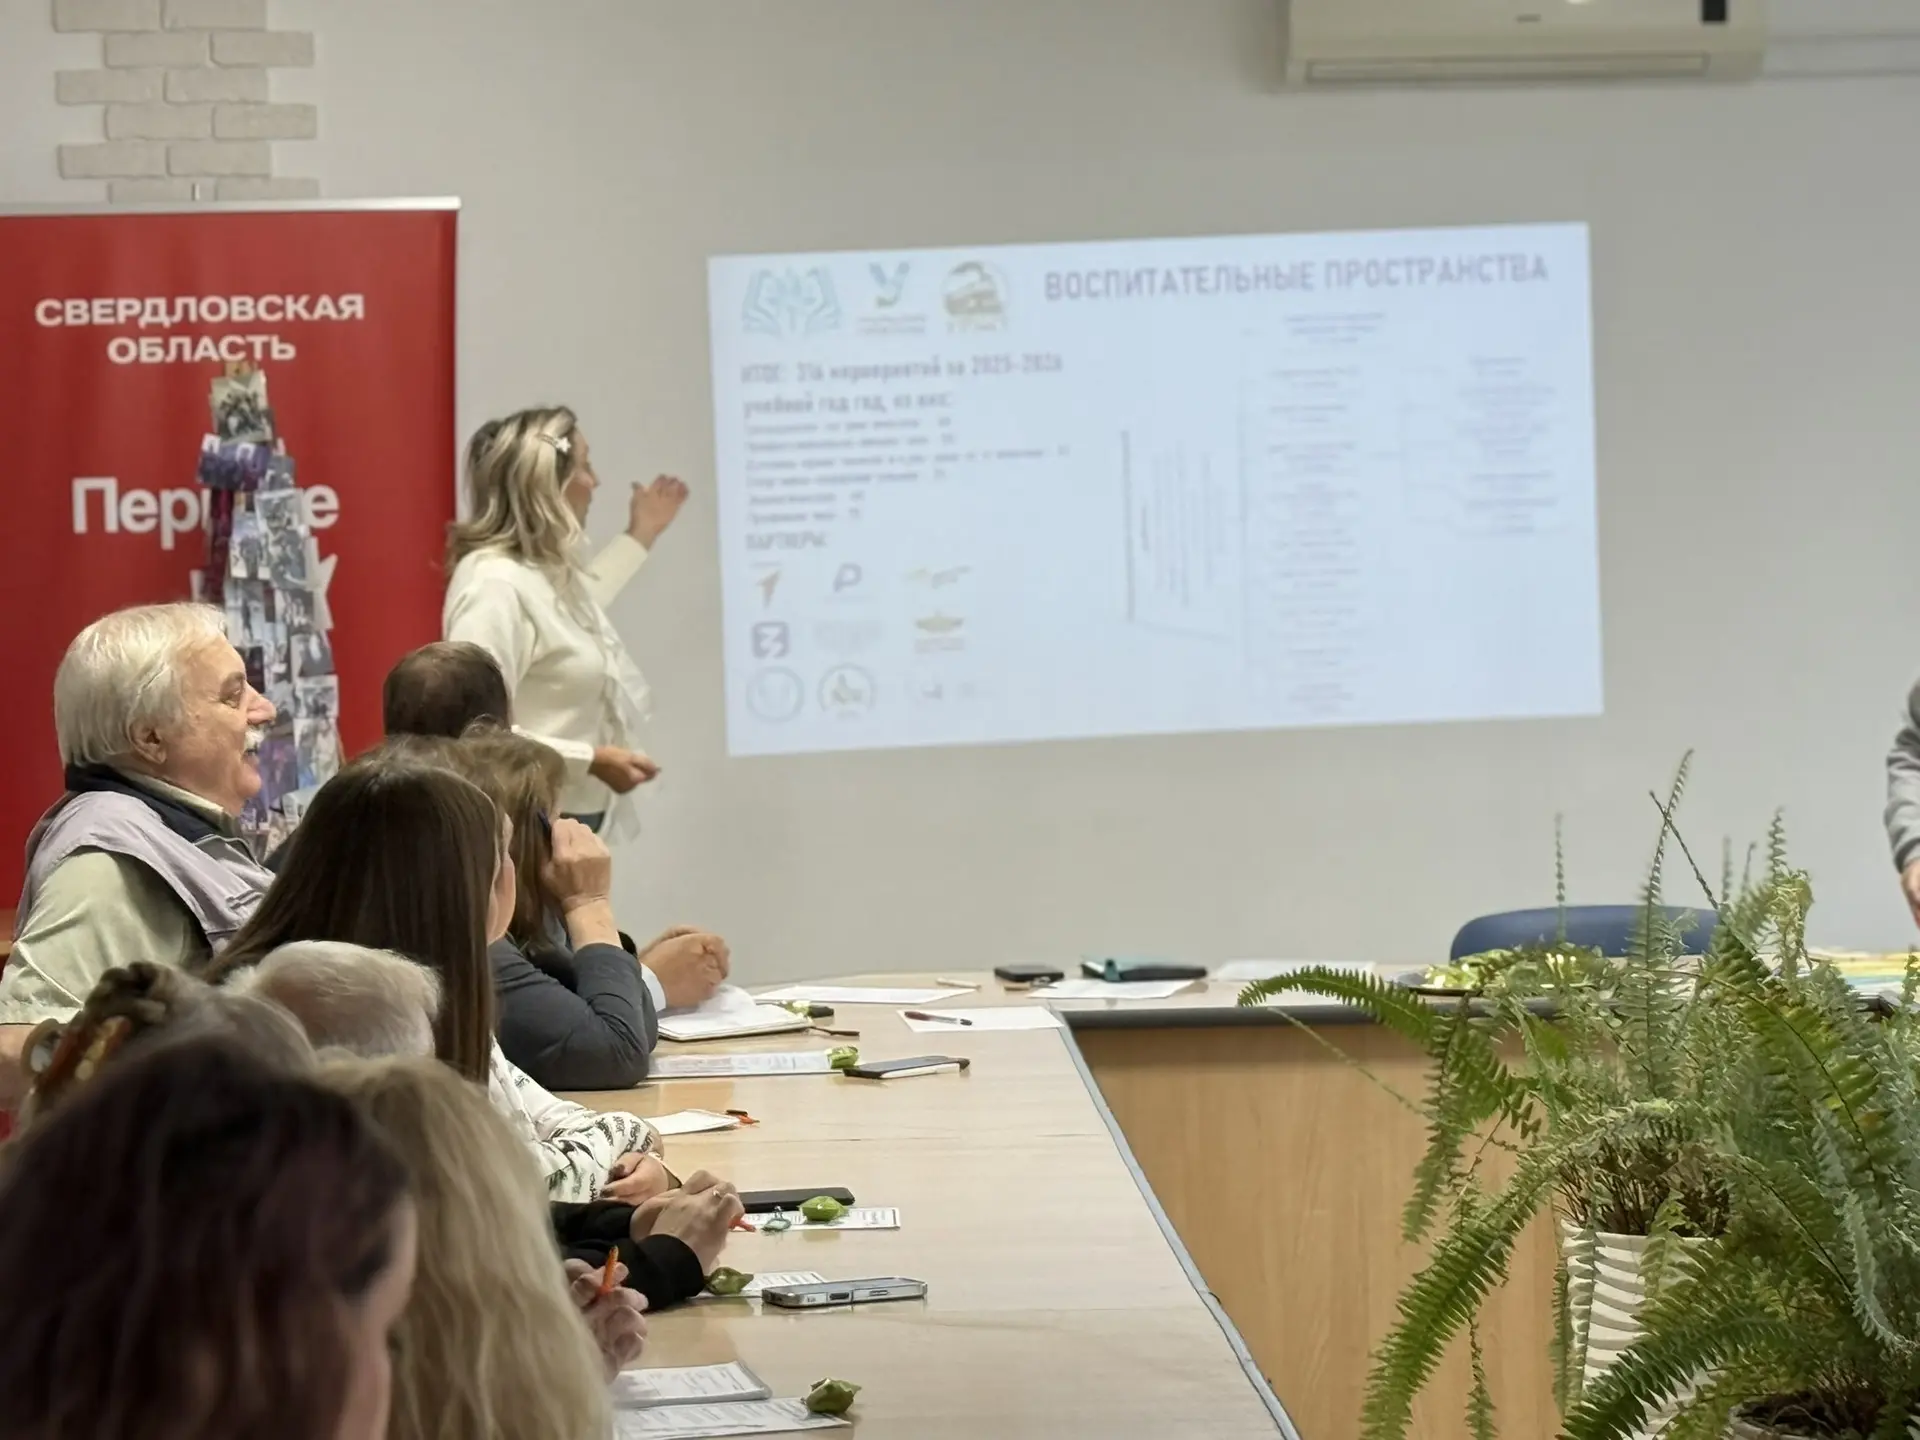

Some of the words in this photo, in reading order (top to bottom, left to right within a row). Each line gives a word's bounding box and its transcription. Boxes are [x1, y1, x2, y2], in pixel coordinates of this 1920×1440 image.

[1045, 260, 1317, 302] ВОСПИТАТЕЛЬНЫЕ
[1324, 252, 1550, 291] ПРОСТРАНСТВА
[35, 294, 366, 328] СВЕРДЛОВСКАЯ
[107, 335, 297, 364] ОБЛАСТЬ
[72, 477, 340, 551] Пере
